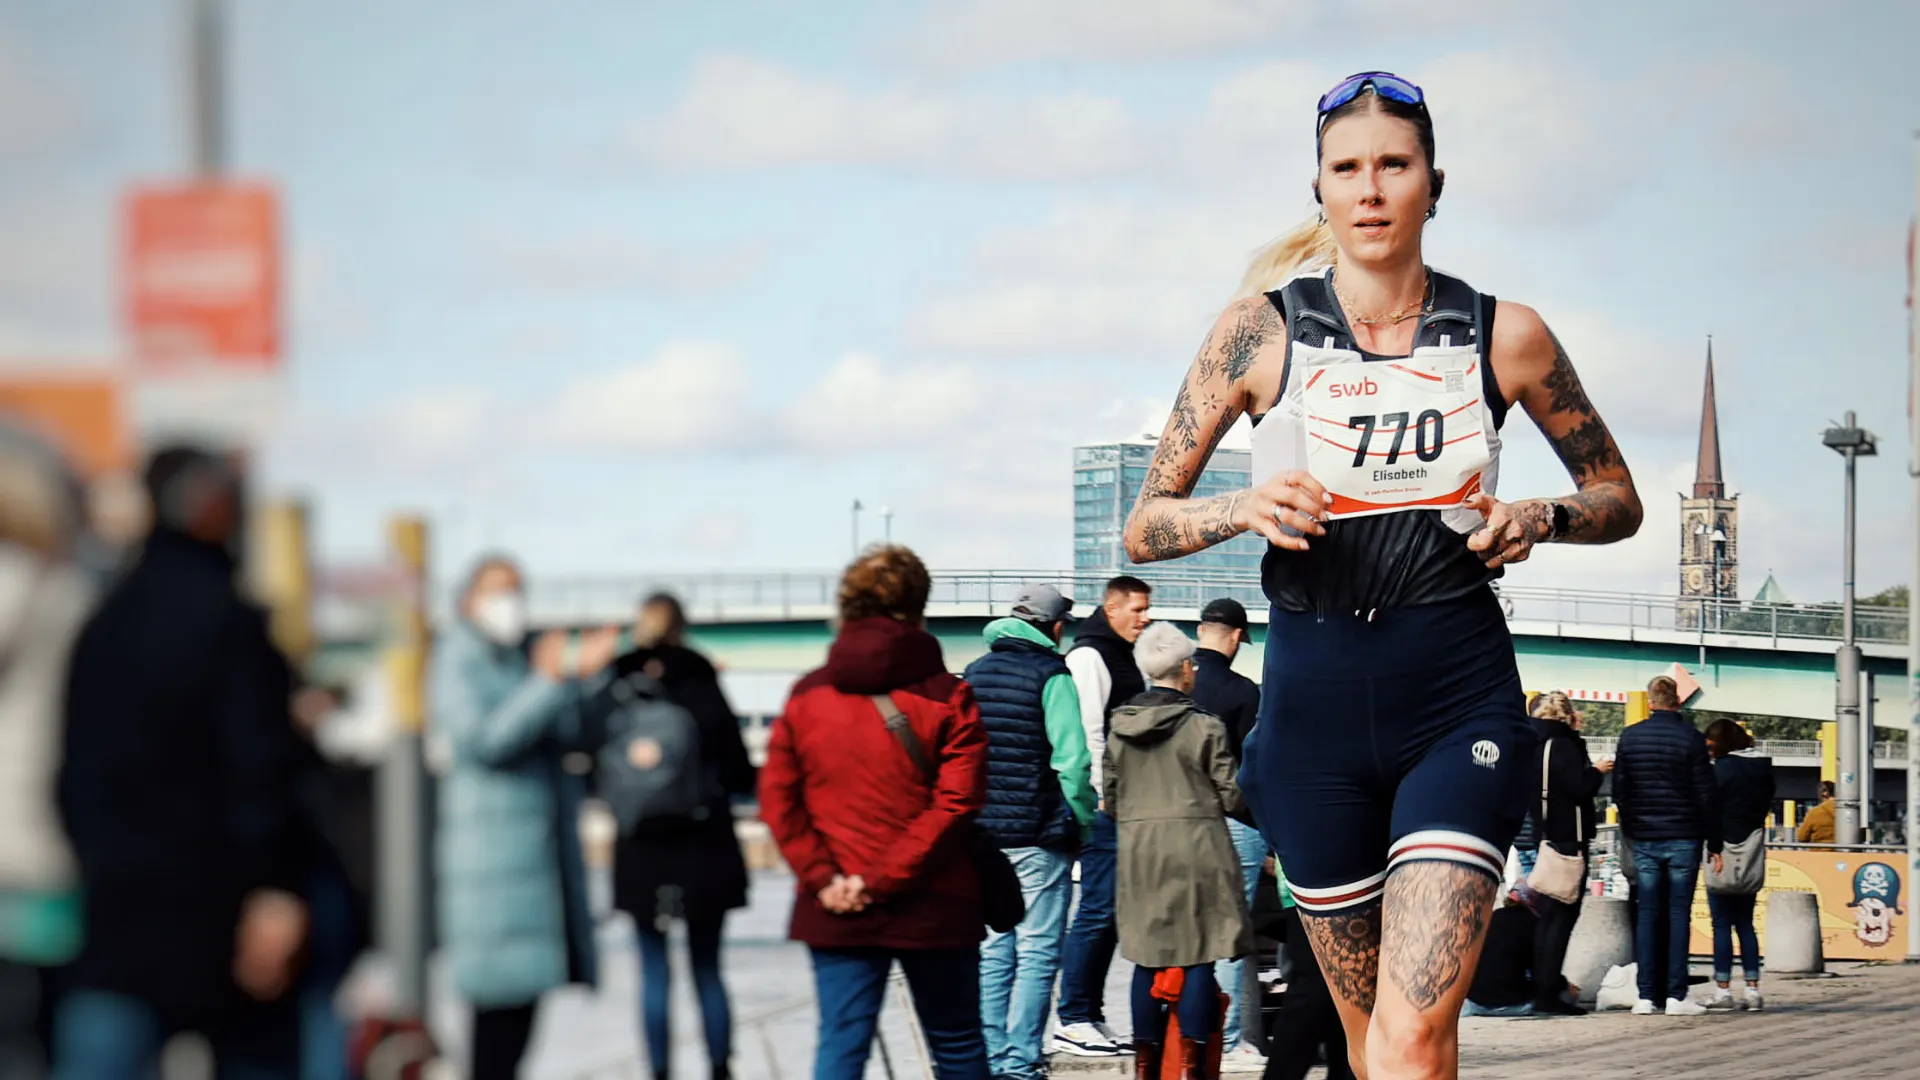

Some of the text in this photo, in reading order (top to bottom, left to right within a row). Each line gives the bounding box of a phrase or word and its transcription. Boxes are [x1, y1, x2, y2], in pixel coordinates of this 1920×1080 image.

[1329, 376, 1378, 398] swb
[1348, 408, 1444, 468] 770
[1372, 467, 1428, 482] Elisabeth
